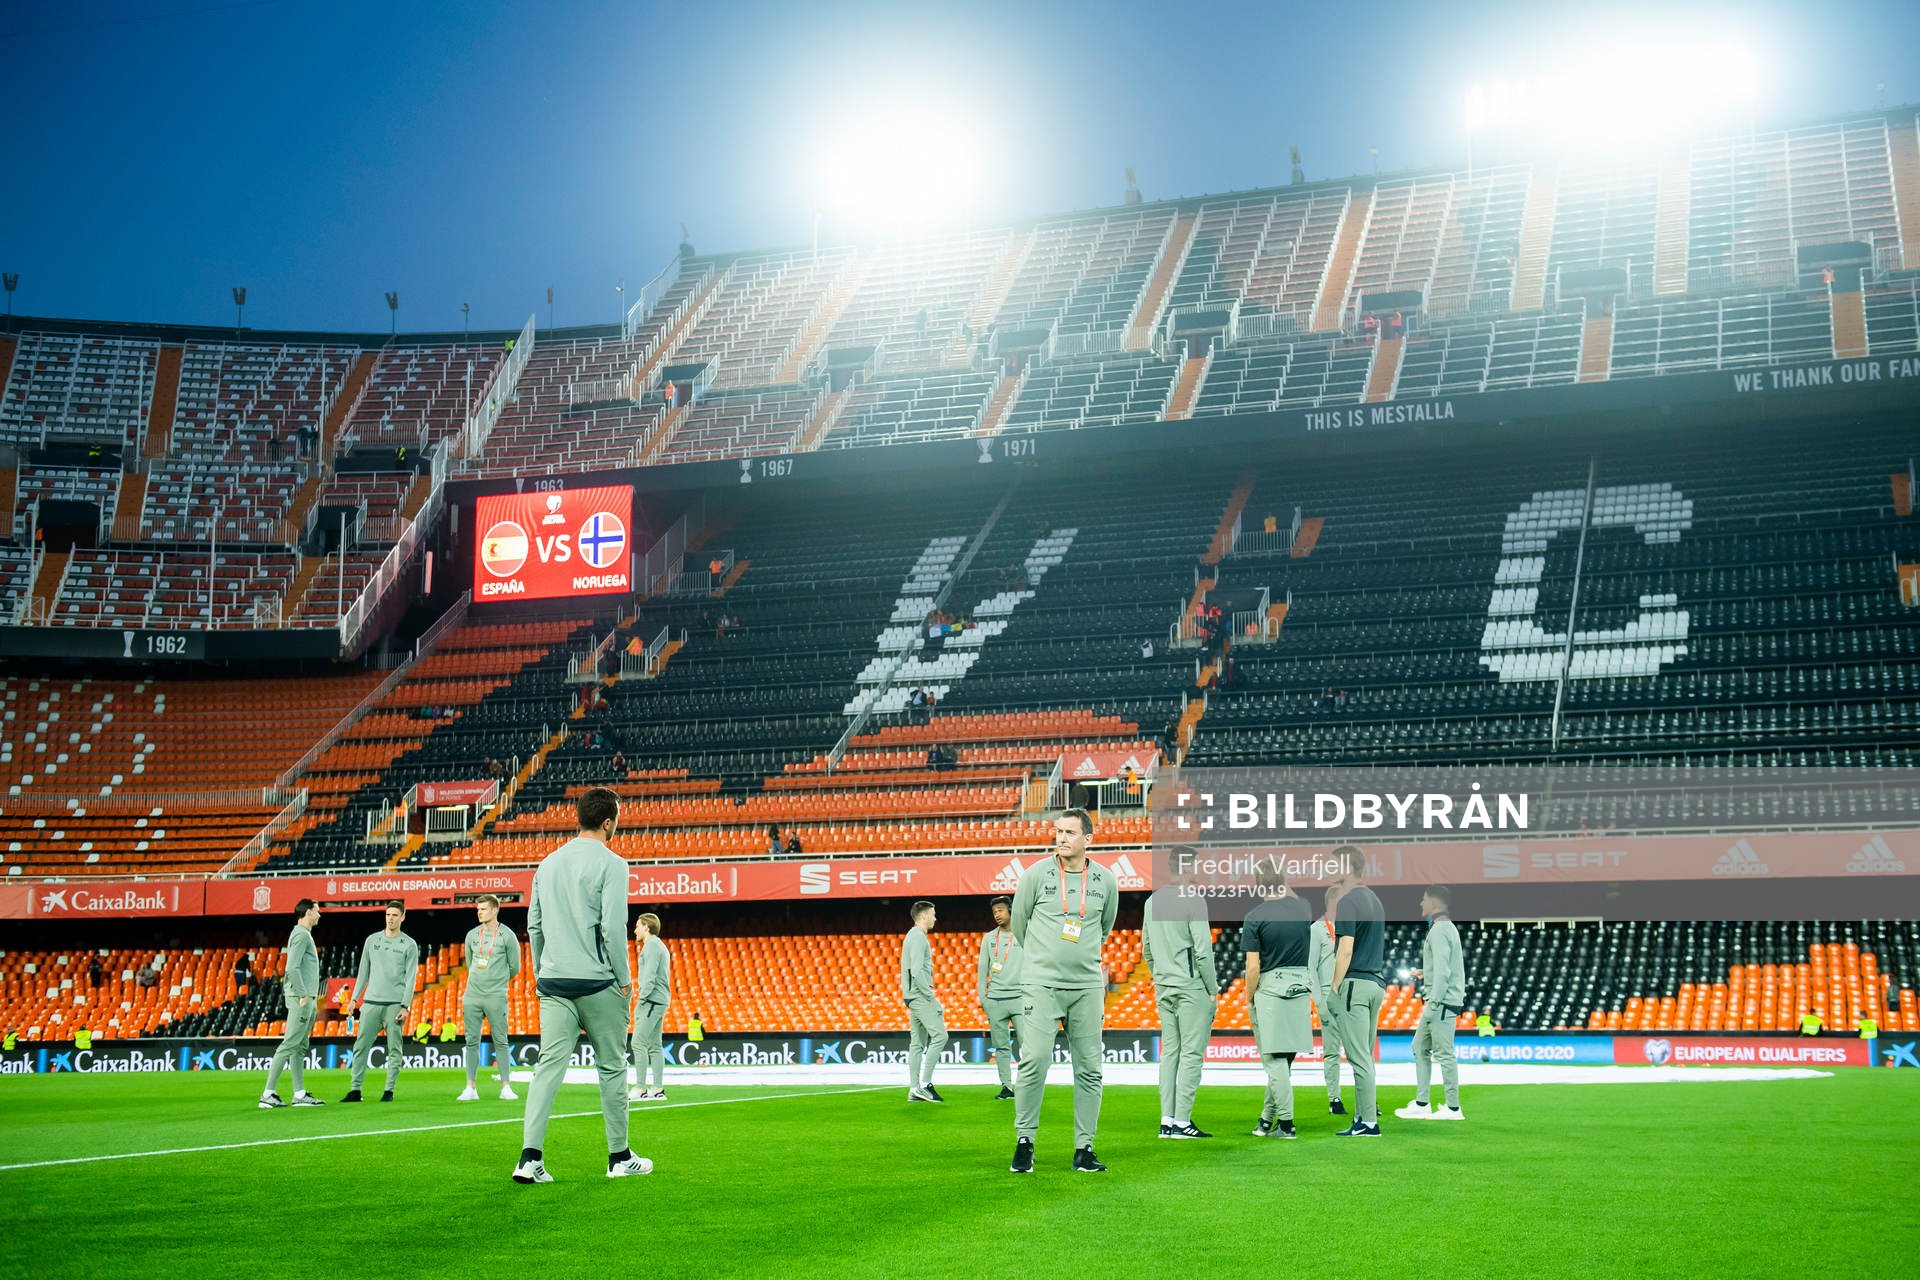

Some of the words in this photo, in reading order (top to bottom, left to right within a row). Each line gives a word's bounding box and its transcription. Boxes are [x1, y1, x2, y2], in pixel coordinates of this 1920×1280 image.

[1734, 372, 1764, 393] WE
[1770, 365, 1834, 389] THANK
[1841, 361, 1881, 383] OUR
[1304, 411, 1342, 431] THIS
[1348, 409, 1364, 427] IS
[1371, 400, 1455, 425] MESTALLA
[1003, 439, 1036, 457] 1971
[761, 459, 793, 478] 1967
[534, 478, 565, 493] 1963
[535, 534, 572, 563] VS
[481, 579, 526, 596] ESPAÑA
[573, 573, 628, 590] NORUEGA
[146, 635, 187, 654] 1962
[1531, 850, 1628, 869] SEAT
[1711, 860, 1770, 876] adidas
[1846, 858, 1907, 874] adidas
[342, 879, 400, 893] SELECCIÓN
[403, 877, 457, 891] ESPAÑOLA
[460, 878, 473, 889] DE
[475, 876, 514, 889] FÚTBOL
[627, 871, 724, 897] CaixaBank
[839, 869, 918, 886] SEAT
[71, 890, 166, 911] CaixaBank
[74, 1050, 177, 1073] CaixaBank
[678, 1041, 796, 1066] CaixaBank
[1206, 1045, 1261, 1059] EUROPE
[1490, 1046, 1531, 1060] EURO
[1534, 1045, 1574, 1060] 2020
[1674, 1045, 1755, 1061] EUROPEAN
[1758, 1046, 1847, 1062] QUALIFIERS
